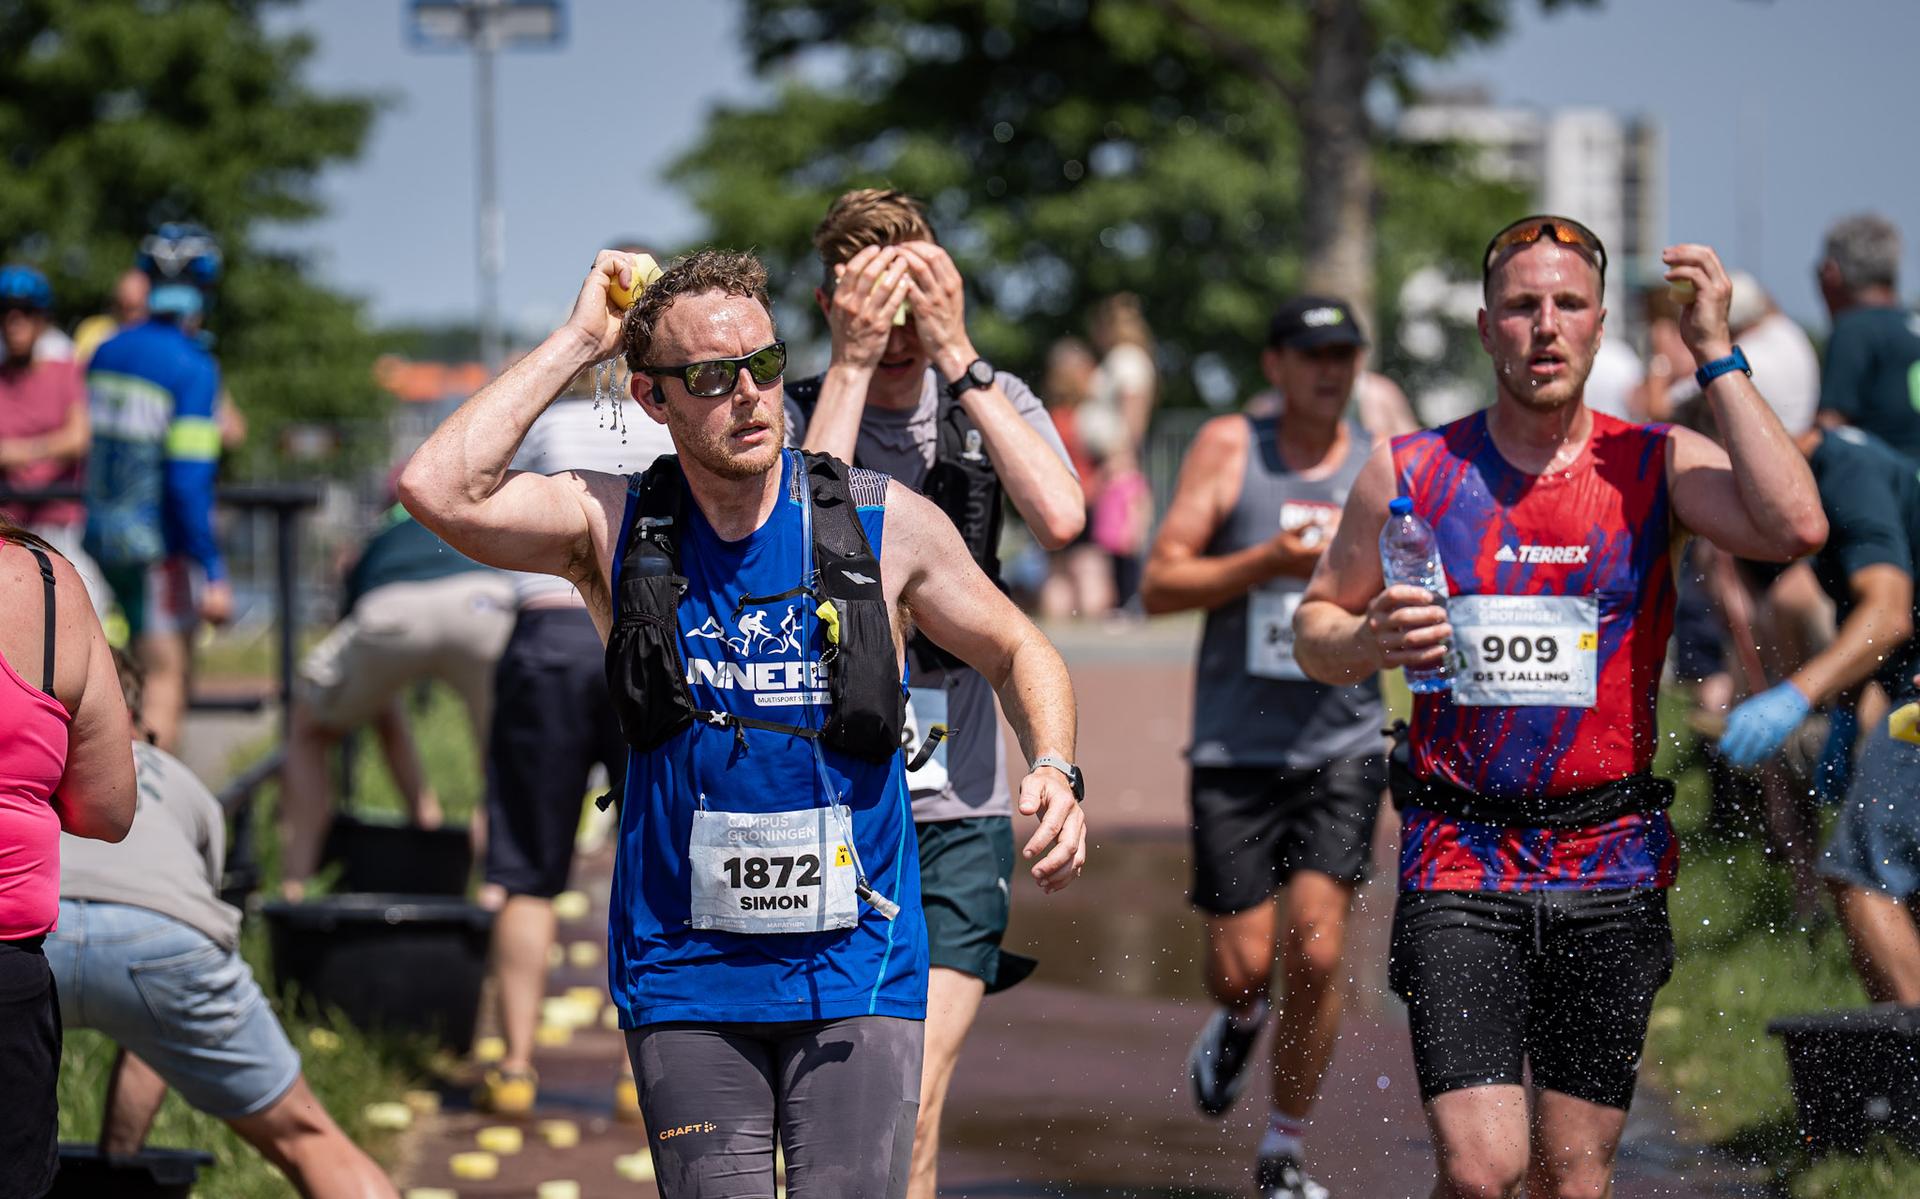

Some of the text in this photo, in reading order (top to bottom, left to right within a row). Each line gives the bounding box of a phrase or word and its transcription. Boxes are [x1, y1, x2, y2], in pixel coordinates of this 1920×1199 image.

[1518, 545, 1590, 564] TERREX
[1482, 635, 1558, 663] 909
[1499, 671, 1569, 683] TJALLING
[757, 695, 797, 703] MULTISPORT
[728, 816, 789, 828] CAMPUS
[728, 826, 816, 841] GRONINGEN
[840, 854, 845, 863] 1
[723, 854, 821, 889] 1872
[740, 895, 808, 910] SIMON
[659, 1124, 702, 1140] CRAFT
